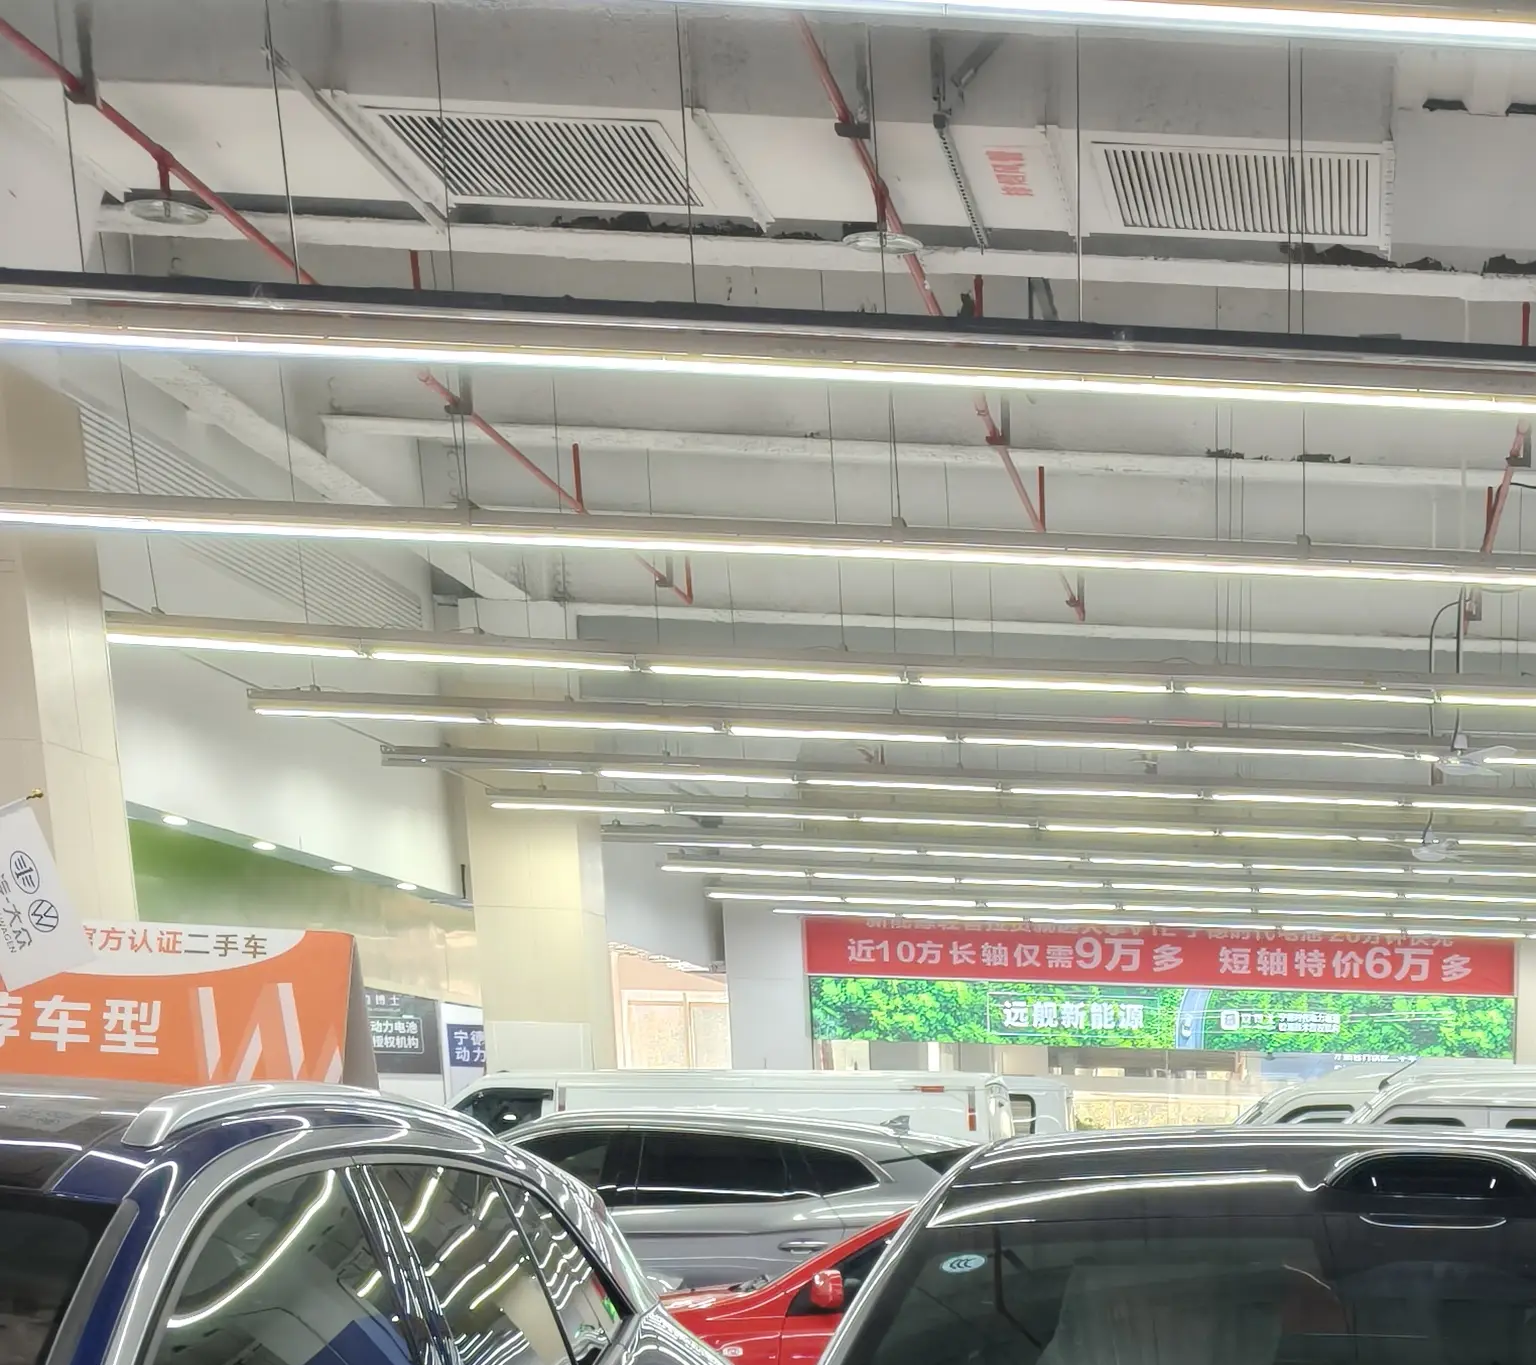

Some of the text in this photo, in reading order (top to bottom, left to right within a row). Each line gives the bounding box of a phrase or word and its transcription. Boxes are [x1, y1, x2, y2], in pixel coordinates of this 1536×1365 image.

[848, 936, 1473, 983] 近10方长轴仅需9万多 短轴特价6万多
